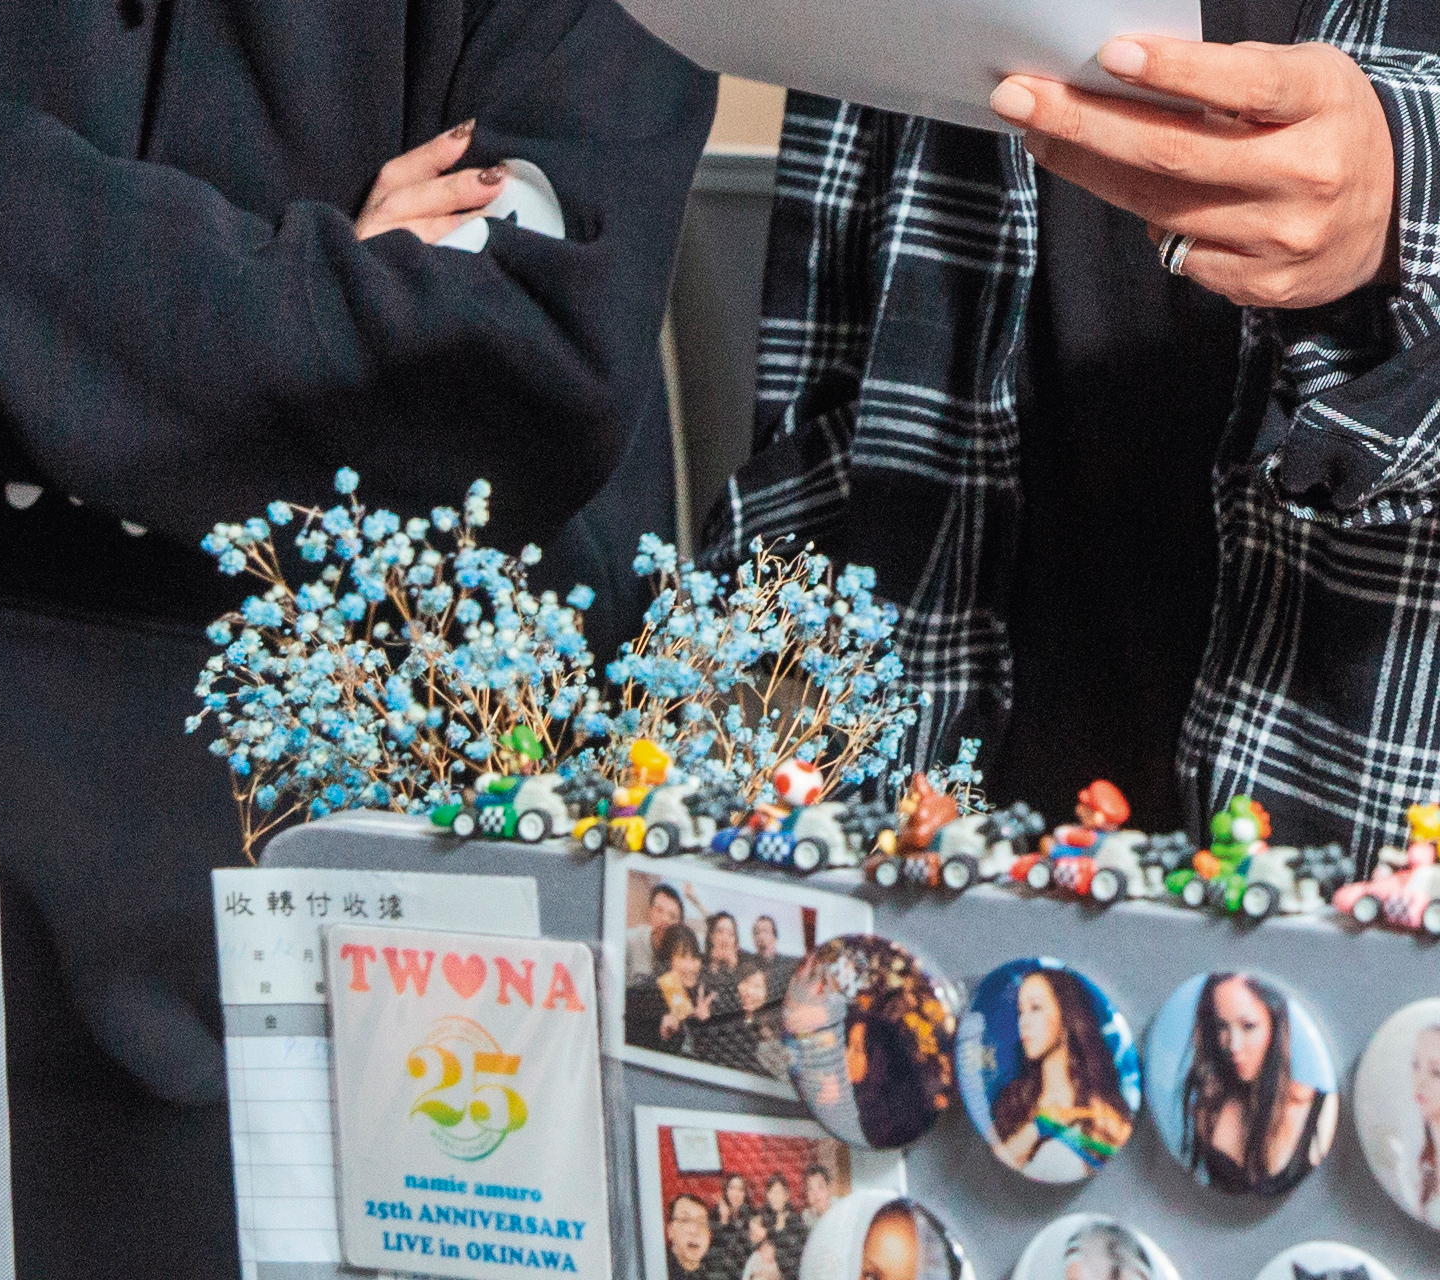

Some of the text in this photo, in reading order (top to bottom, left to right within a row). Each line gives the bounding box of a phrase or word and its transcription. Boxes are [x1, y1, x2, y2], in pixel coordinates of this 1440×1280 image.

[406, 1044, 528, 1133] 25
[404, 1174, 542, 1203] namie amuro
[365, 1200, 586, 1241] 25th ANNIVERSARY
[382, 1231, 578, 1273] LIVE in OKINAWA
